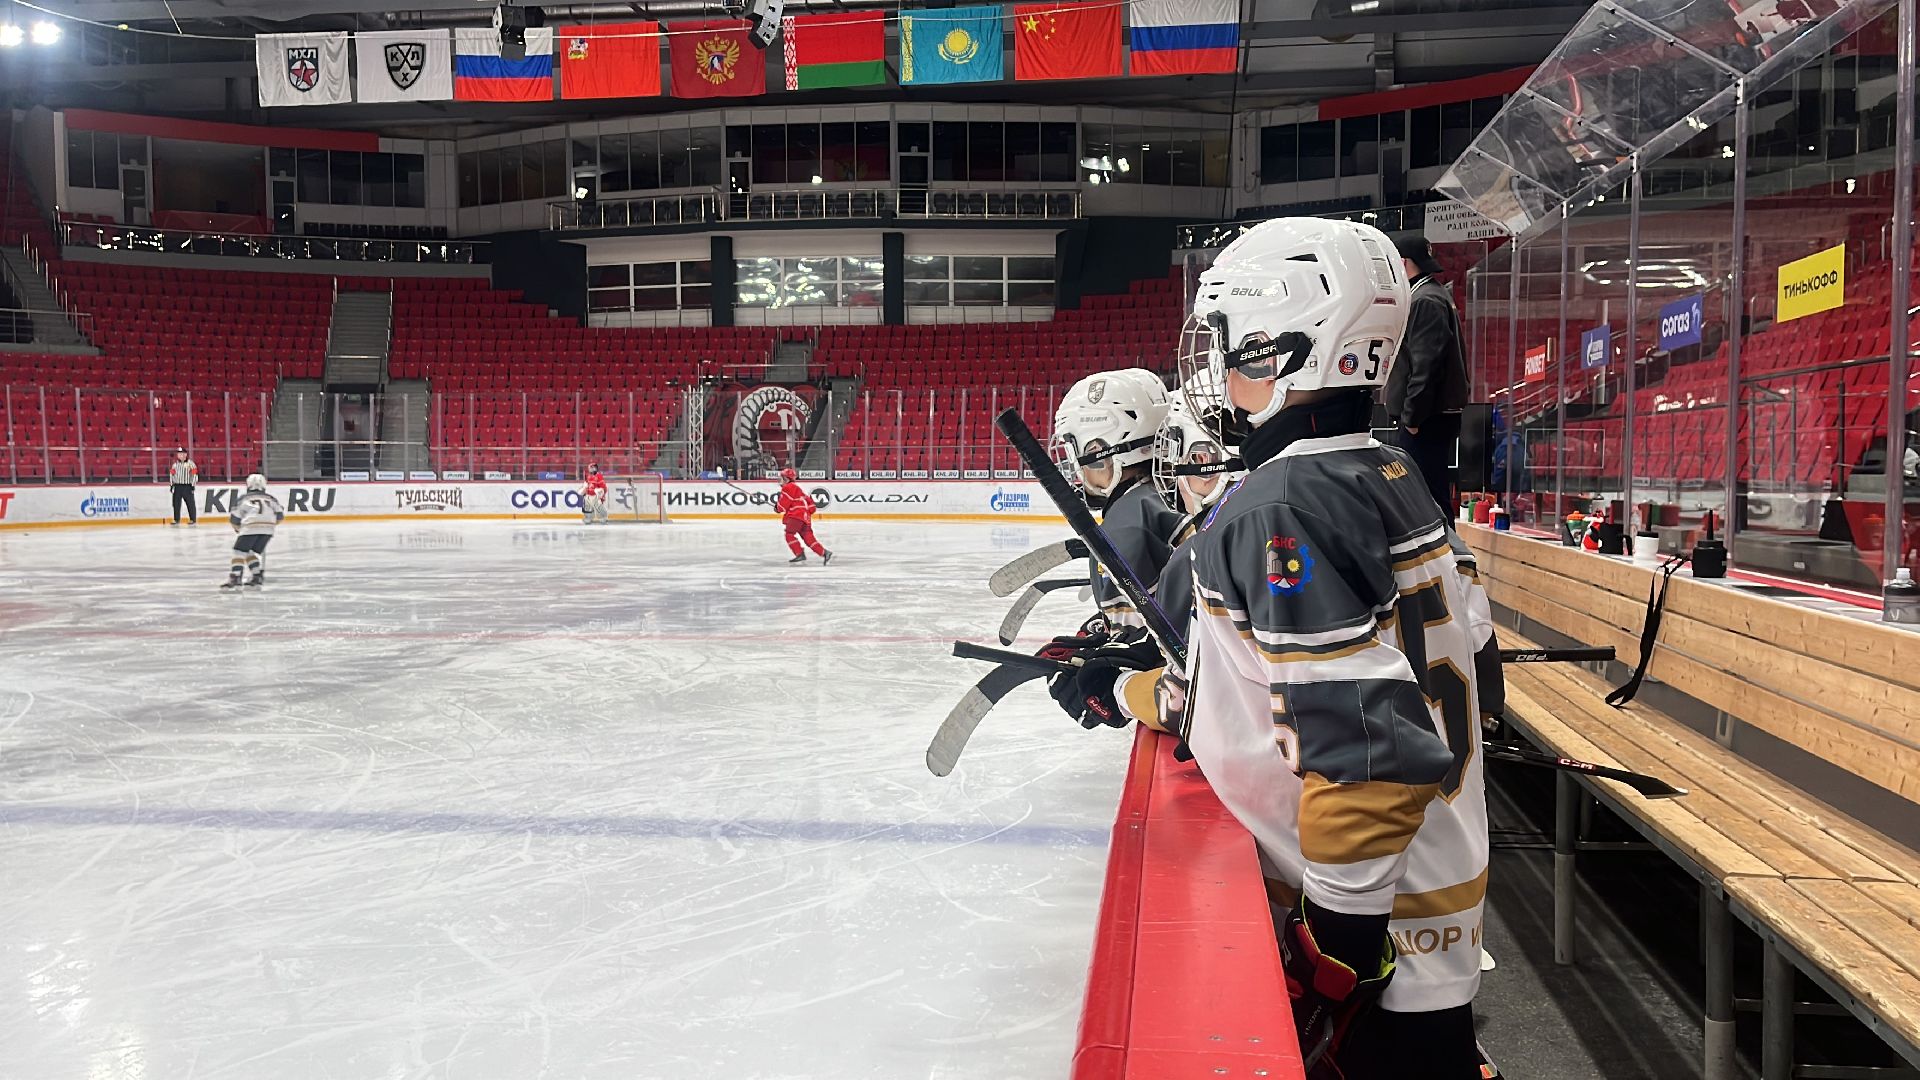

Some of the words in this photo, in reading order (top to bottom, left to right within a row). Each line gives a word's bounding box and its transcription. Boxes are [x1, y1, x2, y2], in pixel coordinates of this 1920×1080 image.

[288, 48, 318, 60] МХЛ
[1783, 270, 1838, 299] ТИНЬКОФФ
[1364, 340, 1384, 380] 5
[96, 497, 129, 507] ГАЗПРОМ
[395, 487, 464, 509] ТУЛЬСКИЙ
[834, 494, 929, 503] VALDAI
